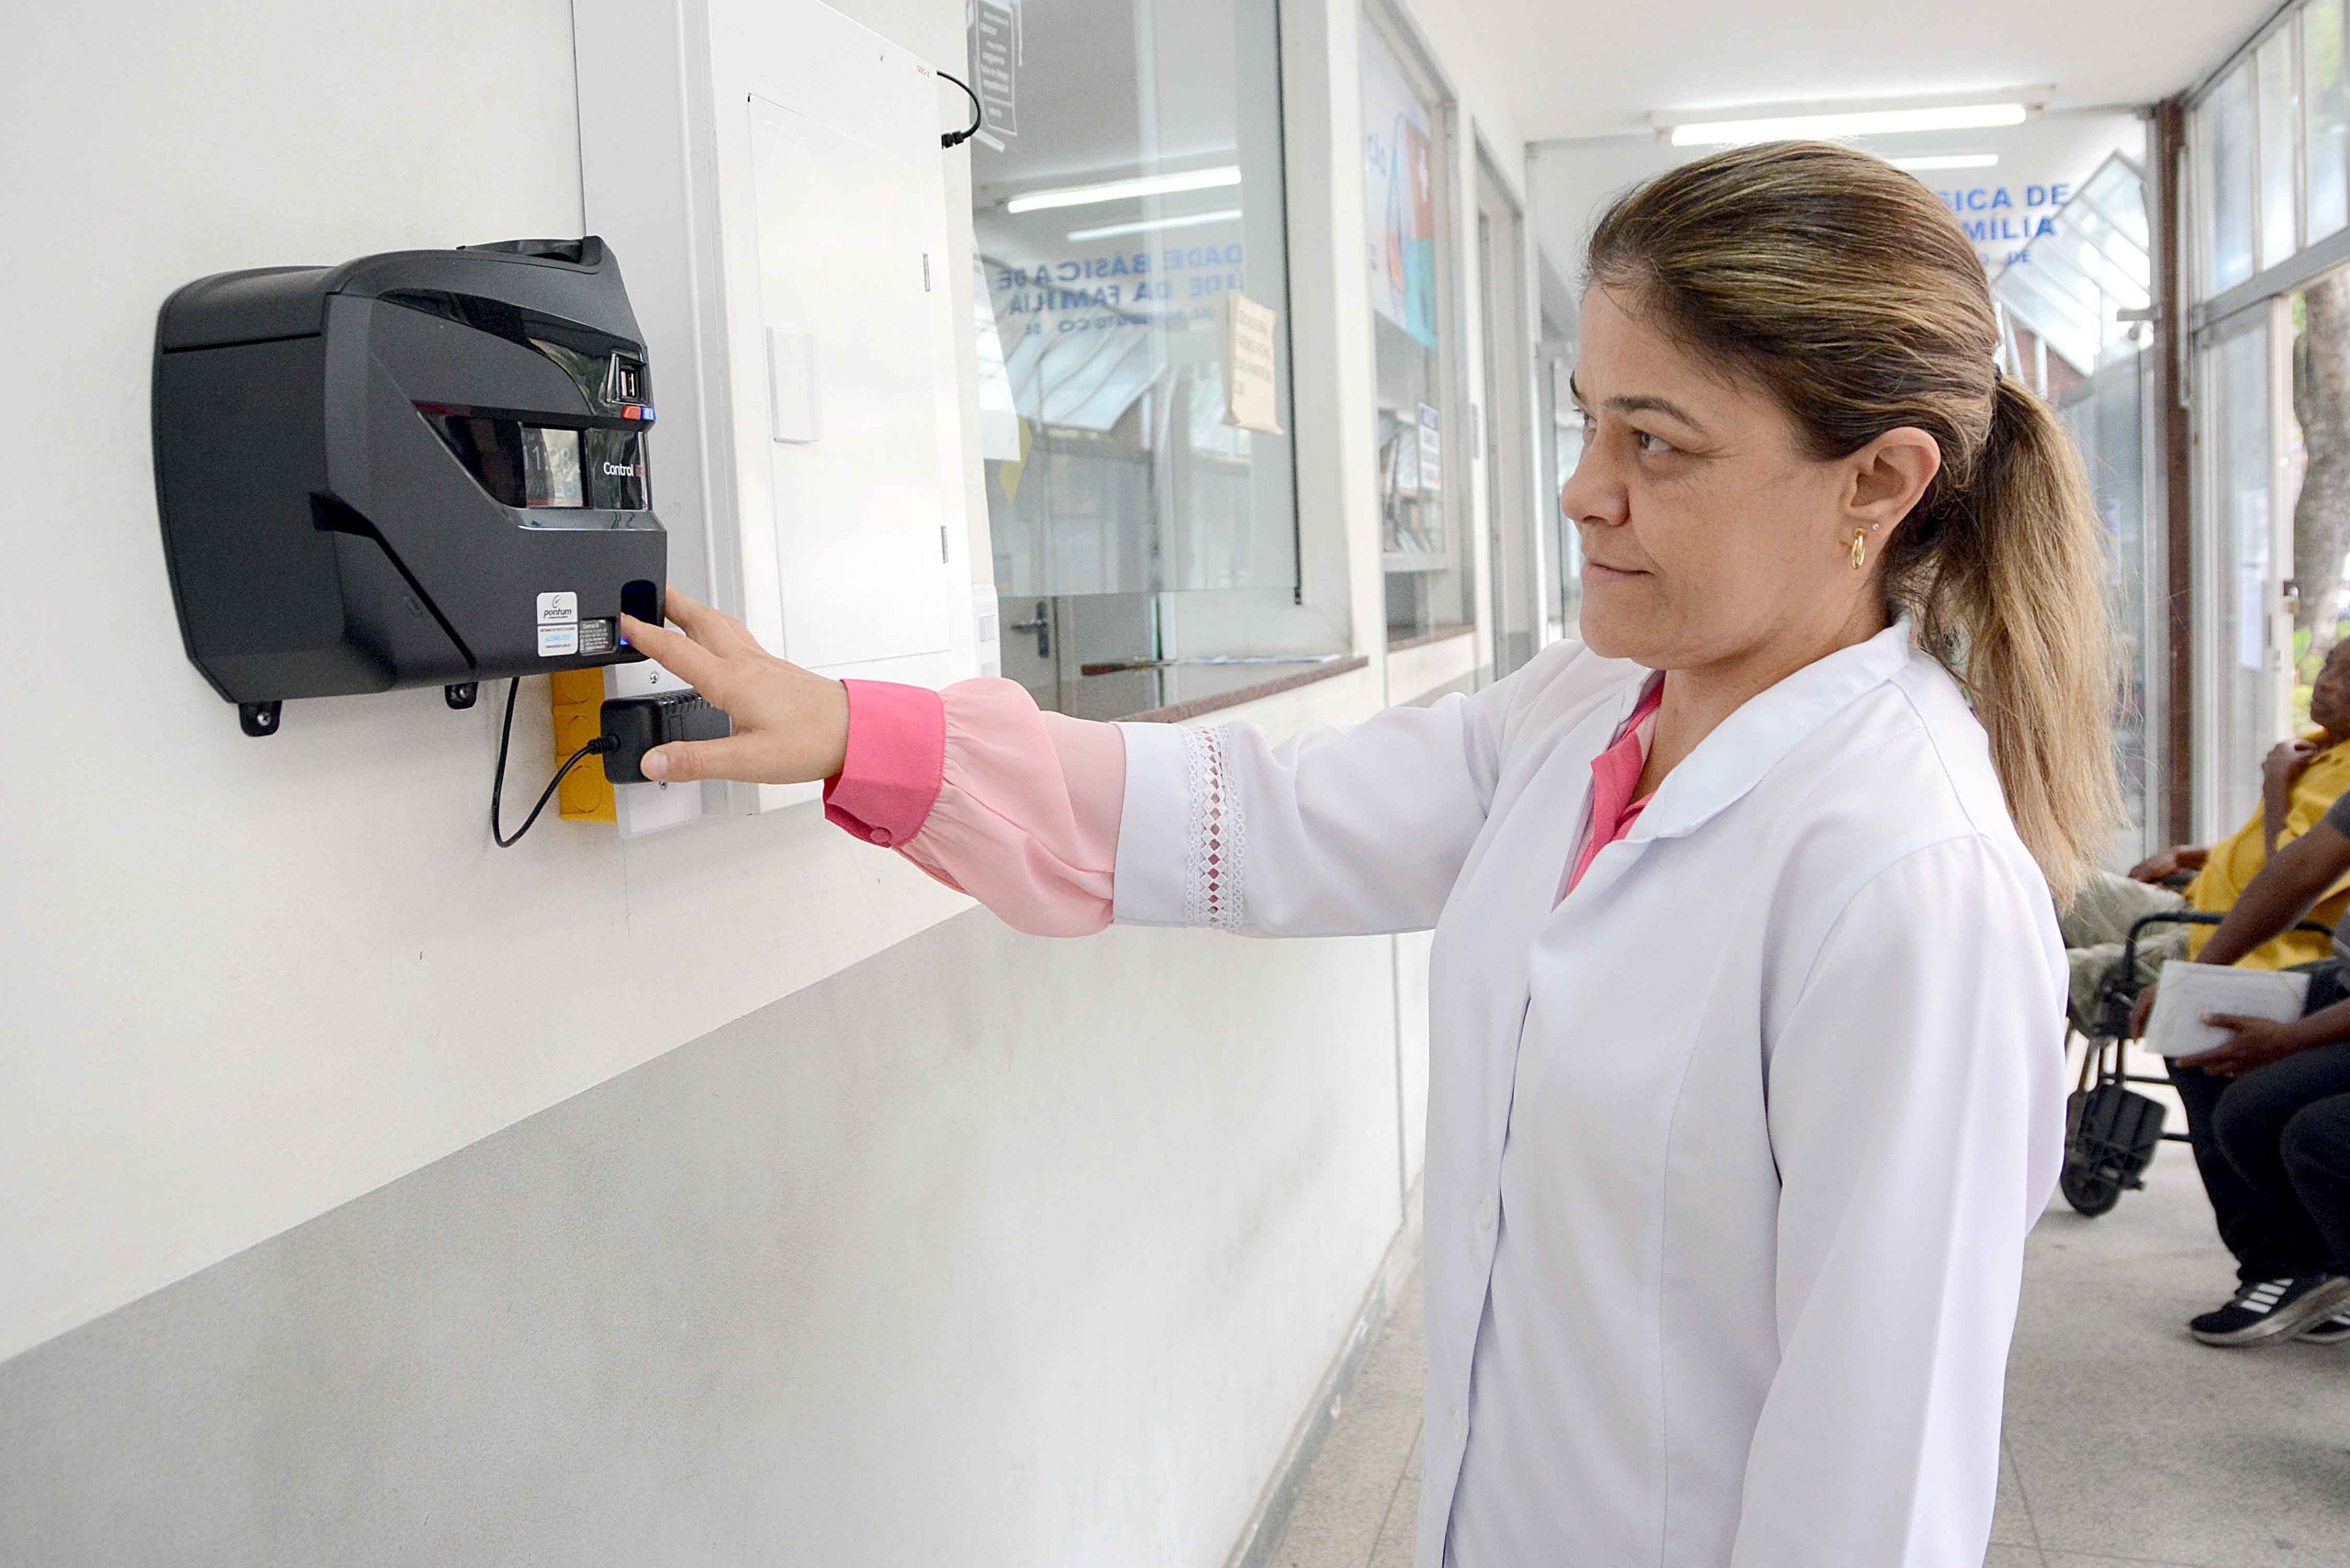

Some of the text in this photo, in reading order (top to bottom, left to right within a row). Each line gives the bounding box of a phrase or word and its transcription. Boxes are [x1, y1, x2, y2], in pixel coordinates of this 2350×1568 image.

[2027, 183, 2070, 207] DE
[603, 461, 633, 476] Control
[543, 608, 572, 618] pontum
